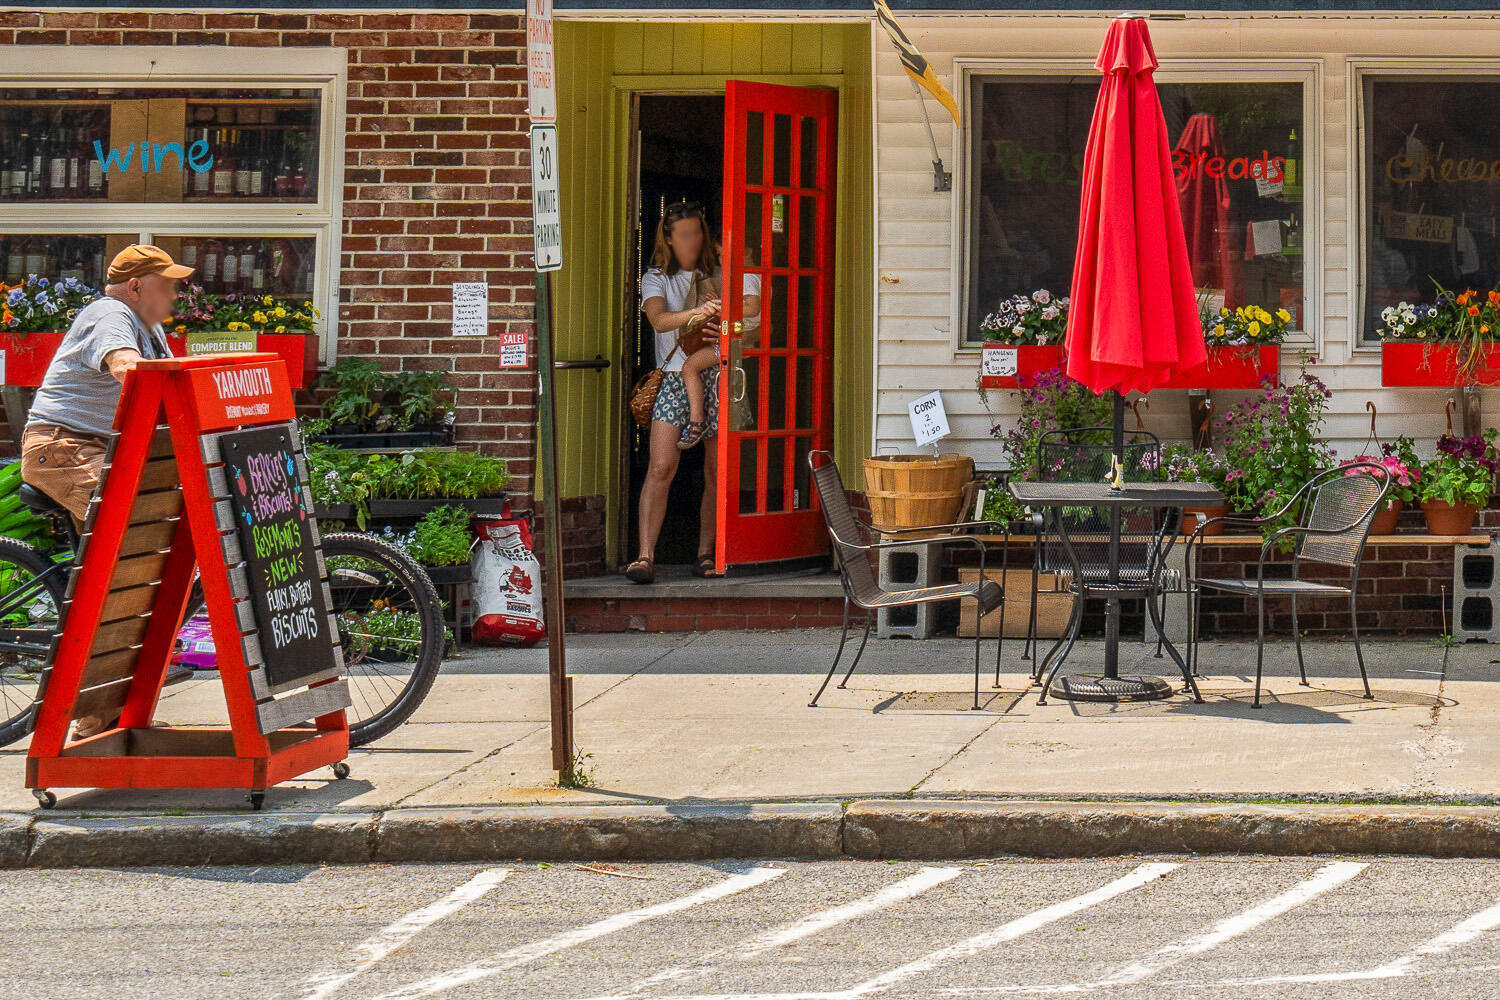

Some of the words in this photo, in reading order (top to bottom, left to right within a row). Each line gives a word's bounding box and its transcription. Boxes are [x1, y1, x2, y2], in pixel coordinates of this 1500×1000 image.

[539, 146, 552, 180] 30
[537, 189, 557, 214] MINUTE
[537, 222, 560, 248] PARKING
[191, 342, 228, 352] COMPOST
[229, 341, 253, 351] BLEND
[503, 334, 524, 344] SALE!
[212, 367, 273, 399] YARMOUTH
[914, 398, 937, 415] CORN
[924, 413, 931, 422] 2
[270, 553, 297, 586] NEW
